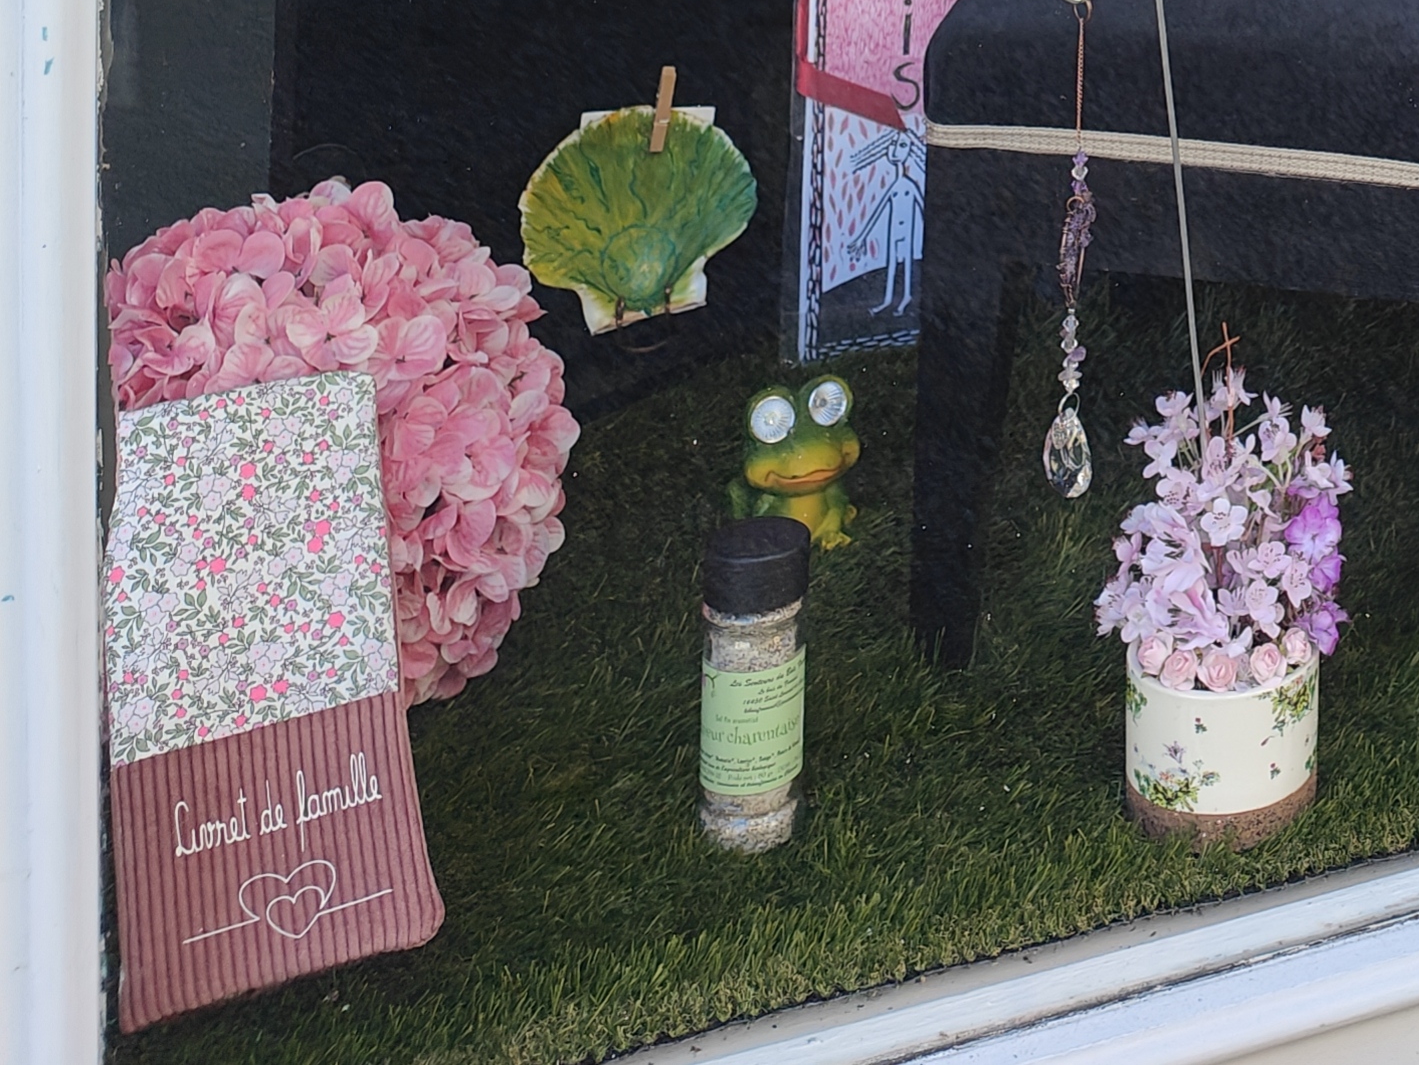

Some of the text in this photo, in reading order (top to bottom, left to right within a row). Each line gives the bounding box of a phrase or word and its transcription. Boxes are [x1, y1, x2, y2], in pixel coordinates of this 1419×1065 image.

[173, 751, 382, 858] Livret de famille
